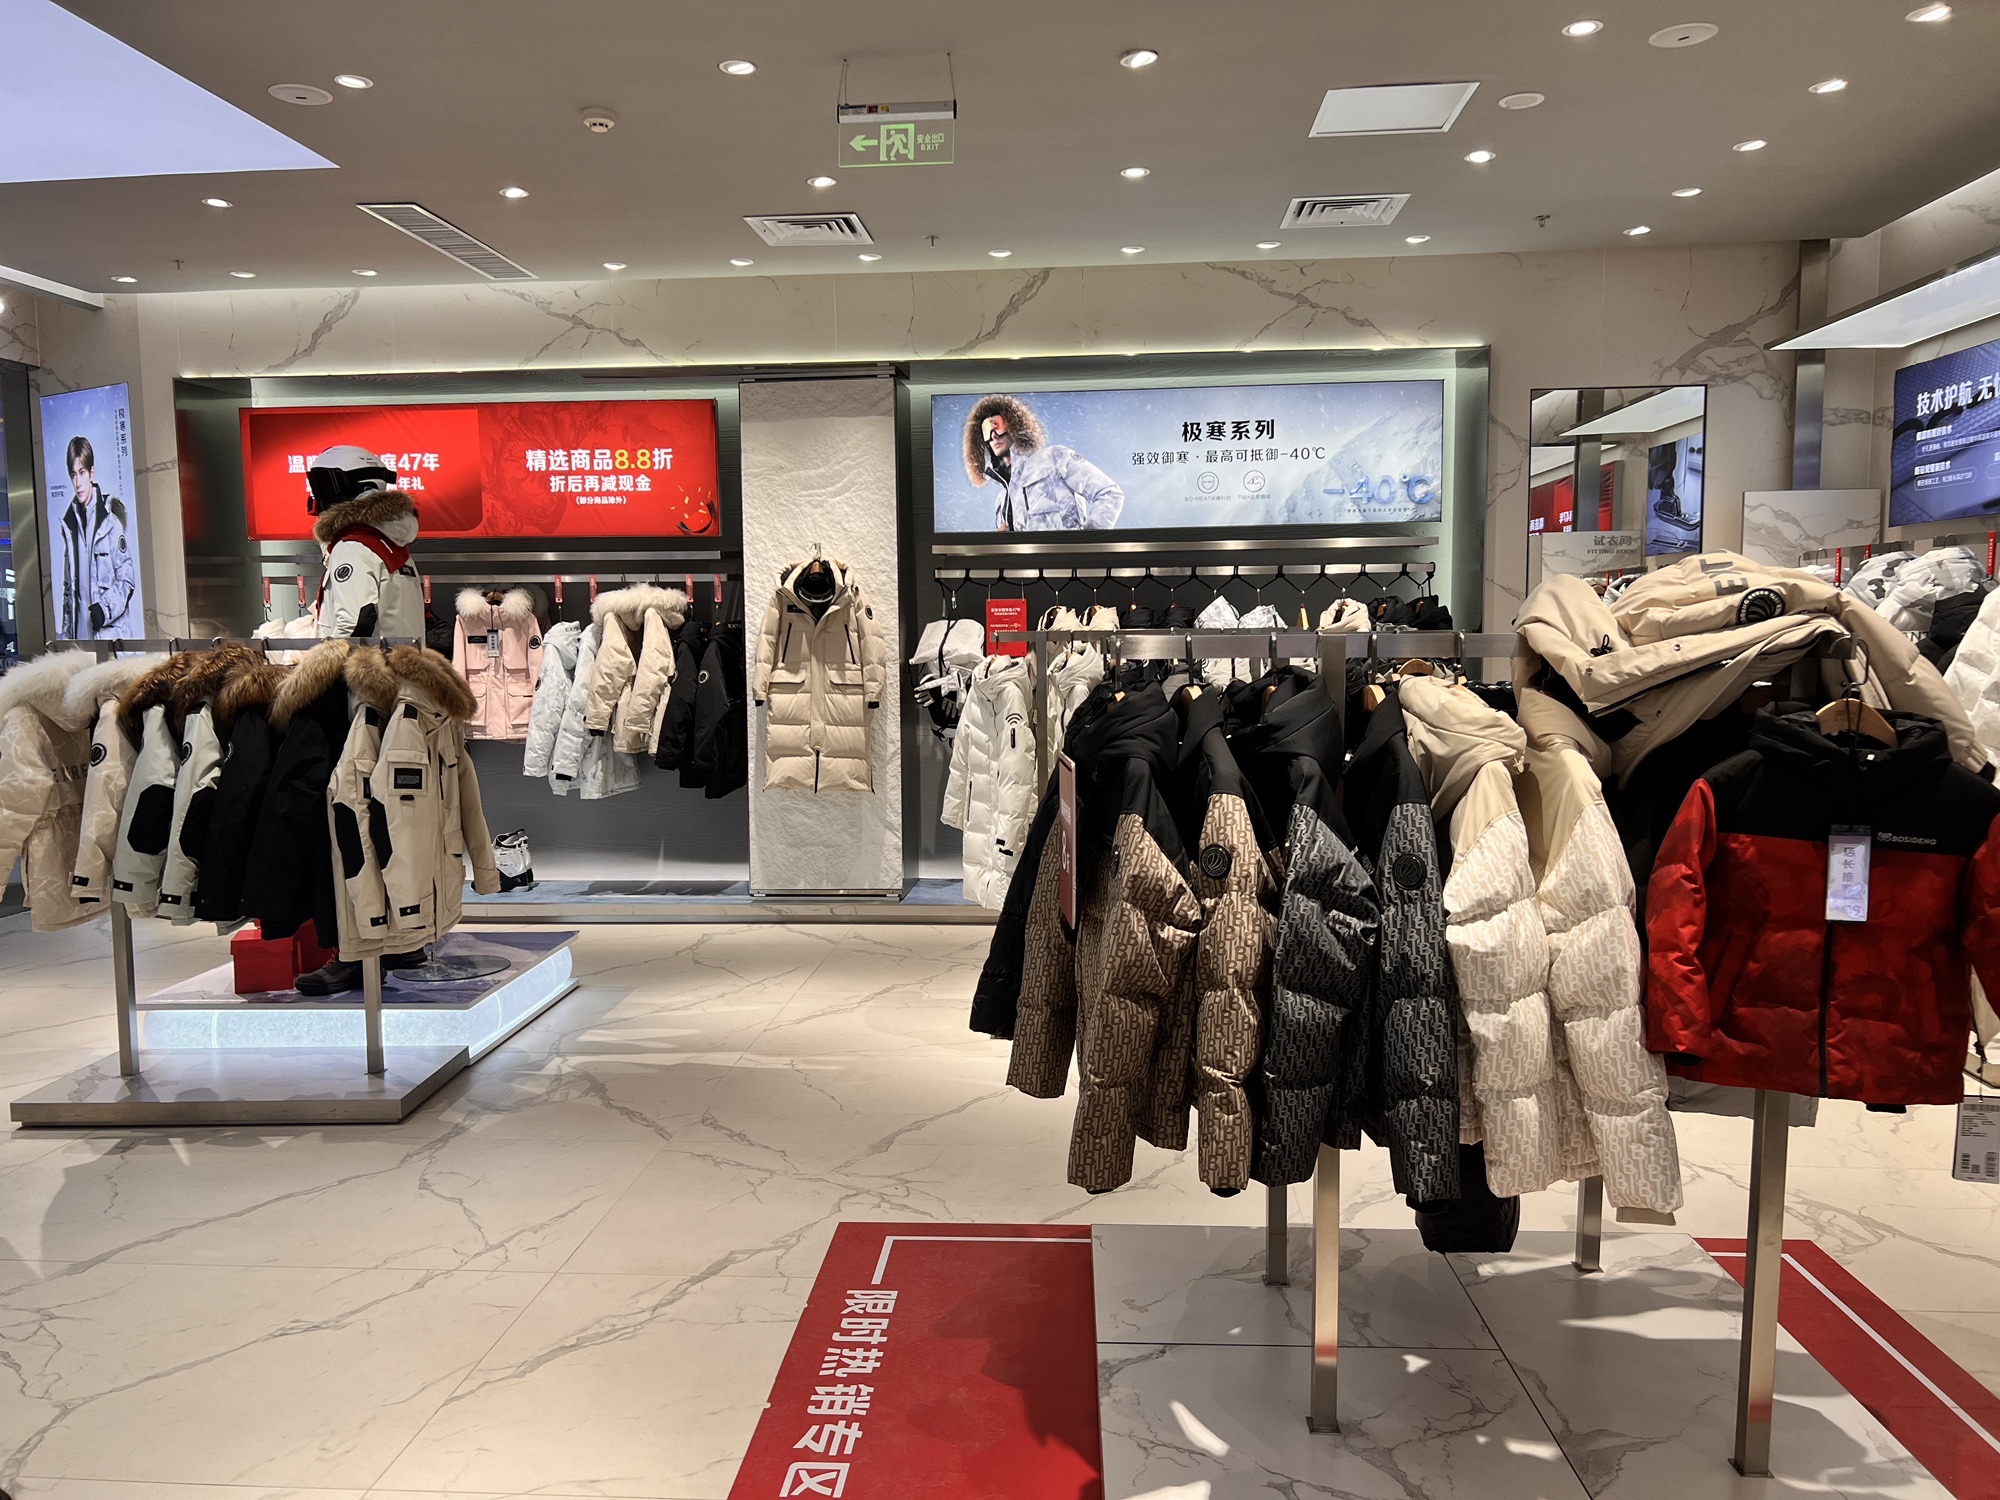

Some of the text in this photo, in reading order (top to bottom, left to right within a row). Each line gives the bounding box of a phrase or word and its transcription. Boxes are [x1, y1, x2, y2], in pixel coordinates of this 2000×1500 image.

[917, 133, 944, 144] 安全出口
[921, 143, 940, 151] EXIT
[1916, 380, 1973, 417] 技术护航
[1182, 419, 1275, 442] 极寒系列
[525, 448, 673, 472] 精选商品8.8折
[549, 474, 652, 493] 折后再减现金
[1593, 535, 1633, 547] 试衣间
[1892, 836, 1937, 845] BOSIDENG
[779, 1290, 898, 1498] 限时热销专区
